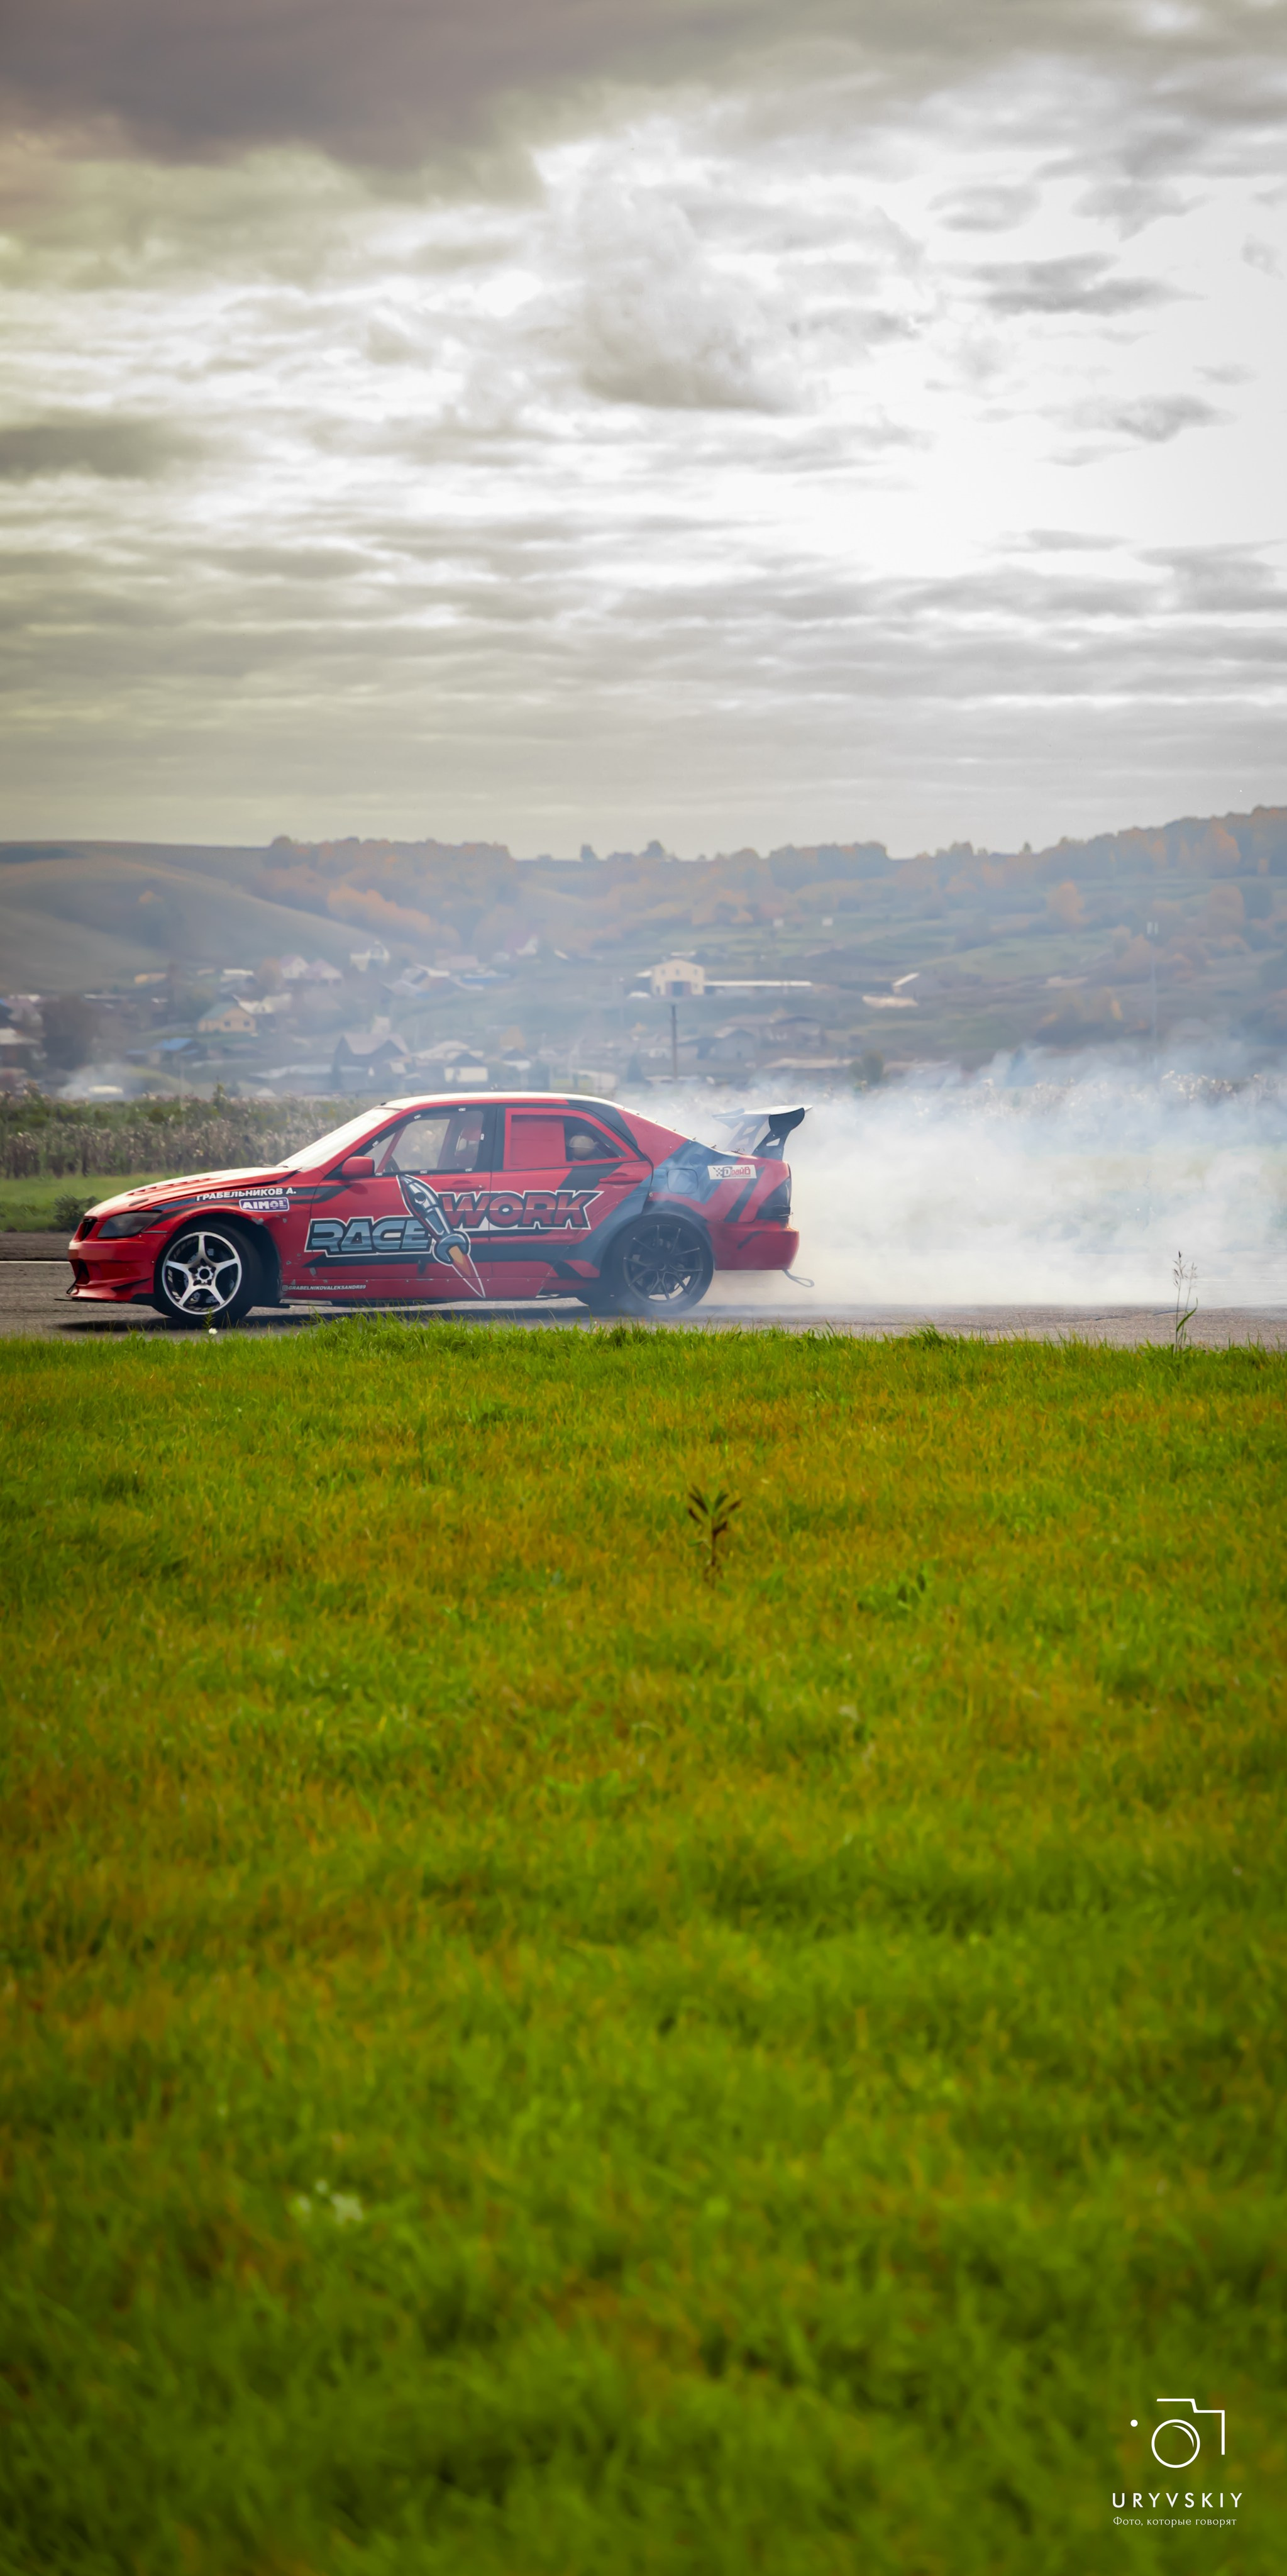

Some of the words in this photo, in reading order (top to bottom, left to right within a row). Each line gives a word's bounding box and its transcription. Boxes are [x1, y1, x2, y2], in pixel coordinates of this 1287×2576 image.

[196, 1188, 283, 1201] ГРАБЕЛЬНИКОВ
[242, 1200, 287, 1209] AIMOL
[440, 1194, 594, 1228] WORK
[309, 1218, 433, 1253] RACE
